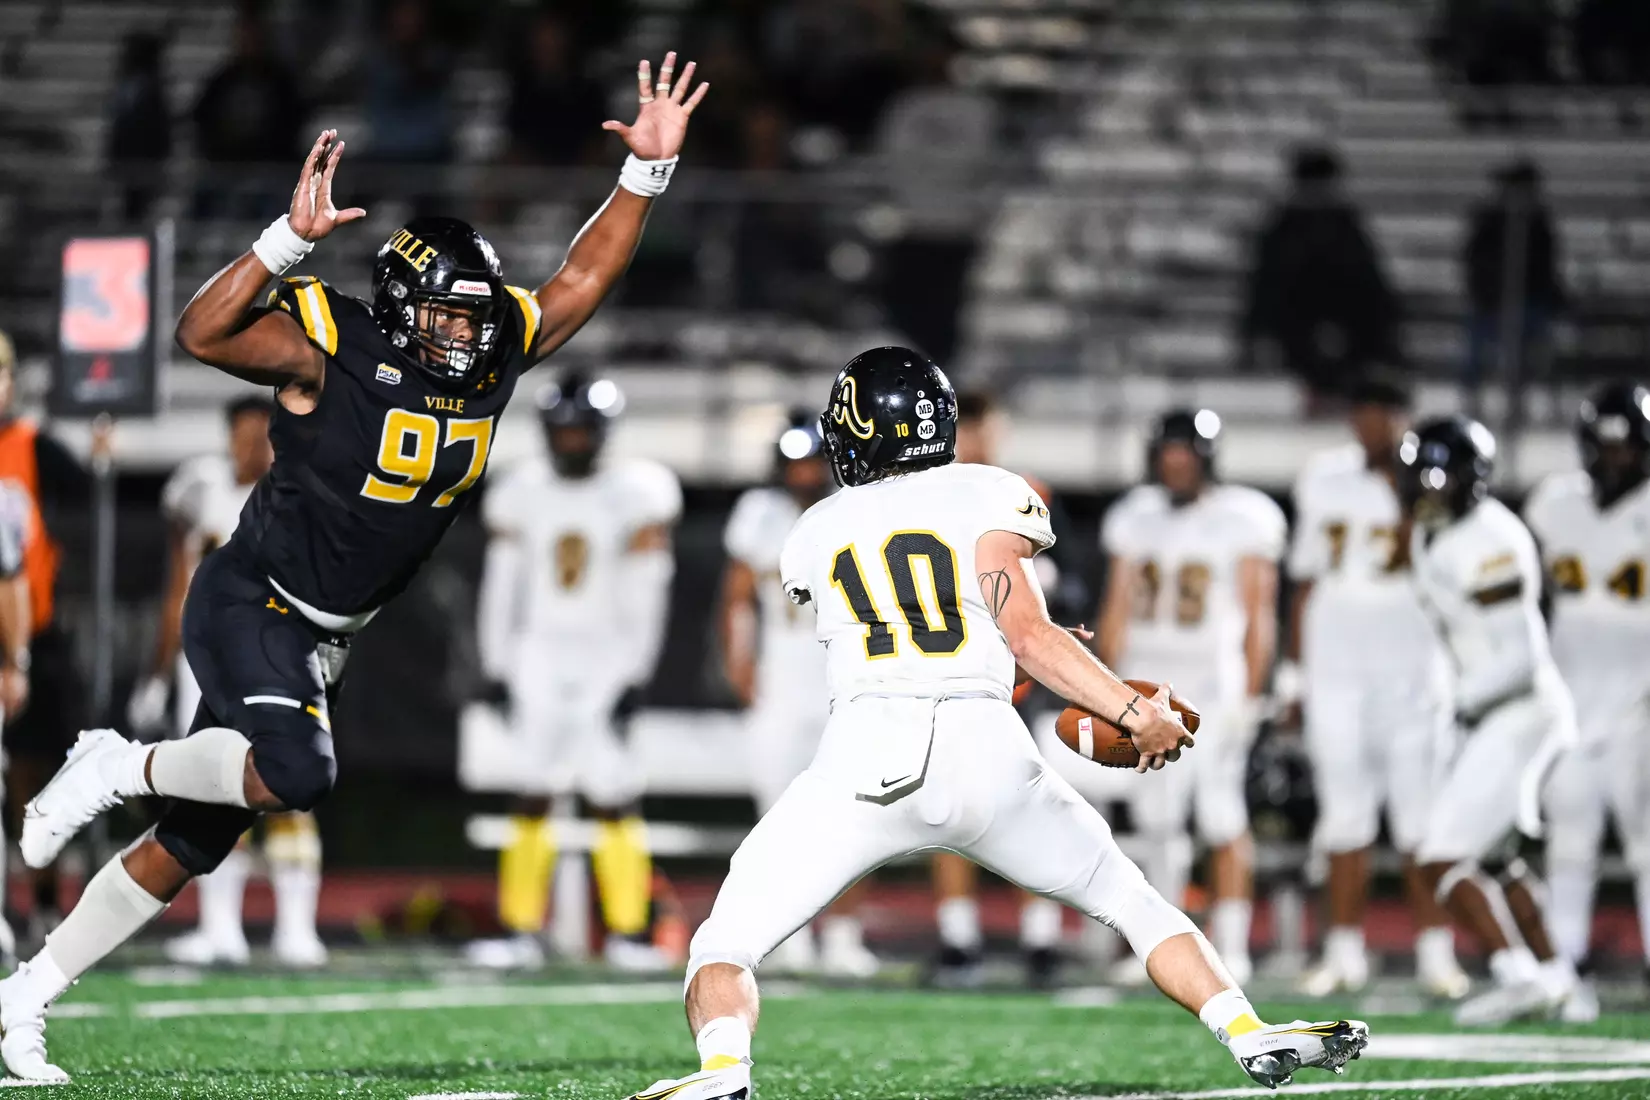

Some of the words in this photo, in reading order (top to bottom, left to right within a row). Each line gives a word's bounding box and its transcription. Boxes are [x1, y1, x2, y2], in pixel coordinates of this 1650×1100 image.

[390, 228, 439, 273] VILLE
[62, 237, 150, 352] 3
[379, 369, 400, 380] PSAC
[424, 396, 465, 413] VILLE
[918, 404, 933, 416] MB
[894, 422, 910, 438] 10
[919, 424, 934, 436] MR
[904, 441, 946, 457] schutt
[359, 408, 494, 508] 97
[828, 528, 989, 661] 10
